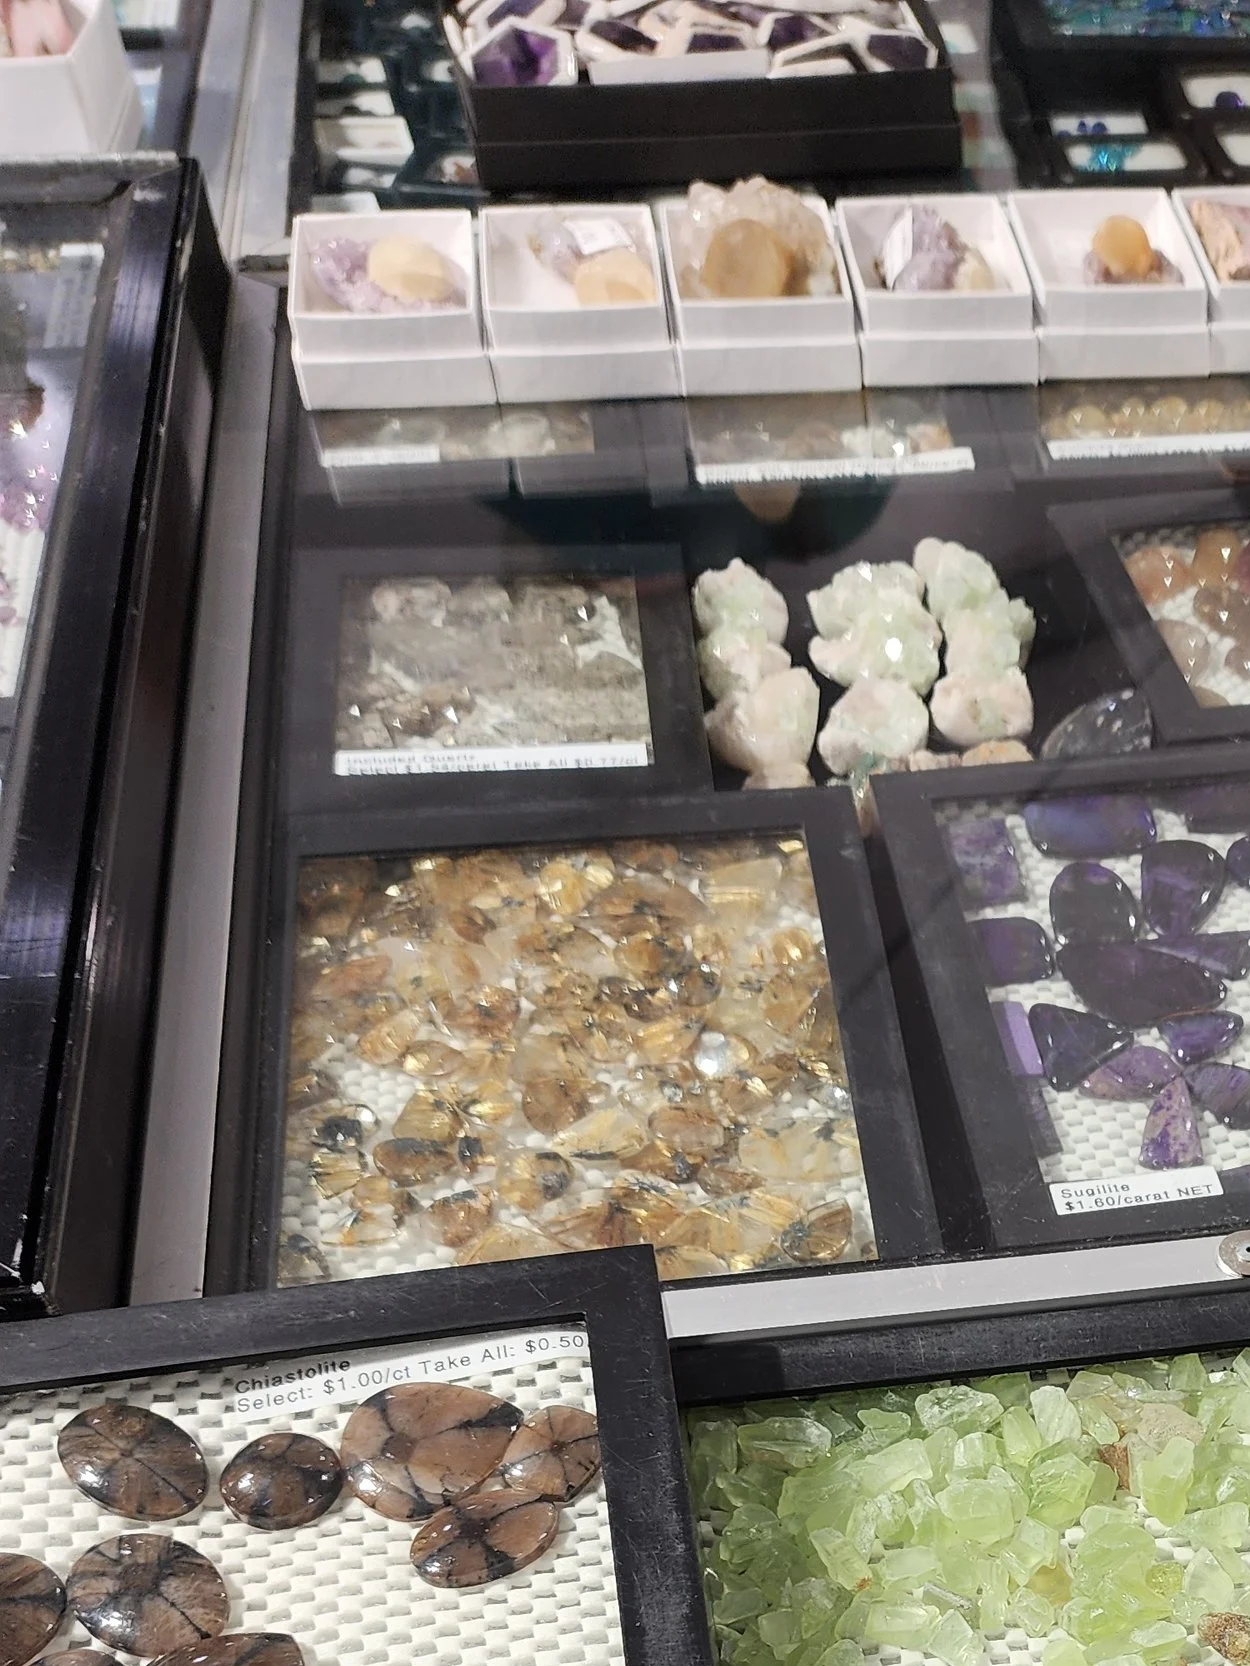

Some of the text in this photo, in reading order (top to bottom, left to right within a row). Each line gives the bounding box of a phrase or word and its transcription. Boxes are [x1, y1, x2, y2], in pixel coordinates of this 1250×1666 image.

[1060, 1182, 1131, 1200] Sugilite
[1064, 1184, 1214, 1212] $1.60/carat NET
[234, 1359, 351, 1395] Chiastolite
[236, 1386, 314, 1413] Select:
[322, 1367, 412, 1396] $1.00/ct
[418, 1351, 472, 1376] Take
[480, 1344, 517, 1364] All:
